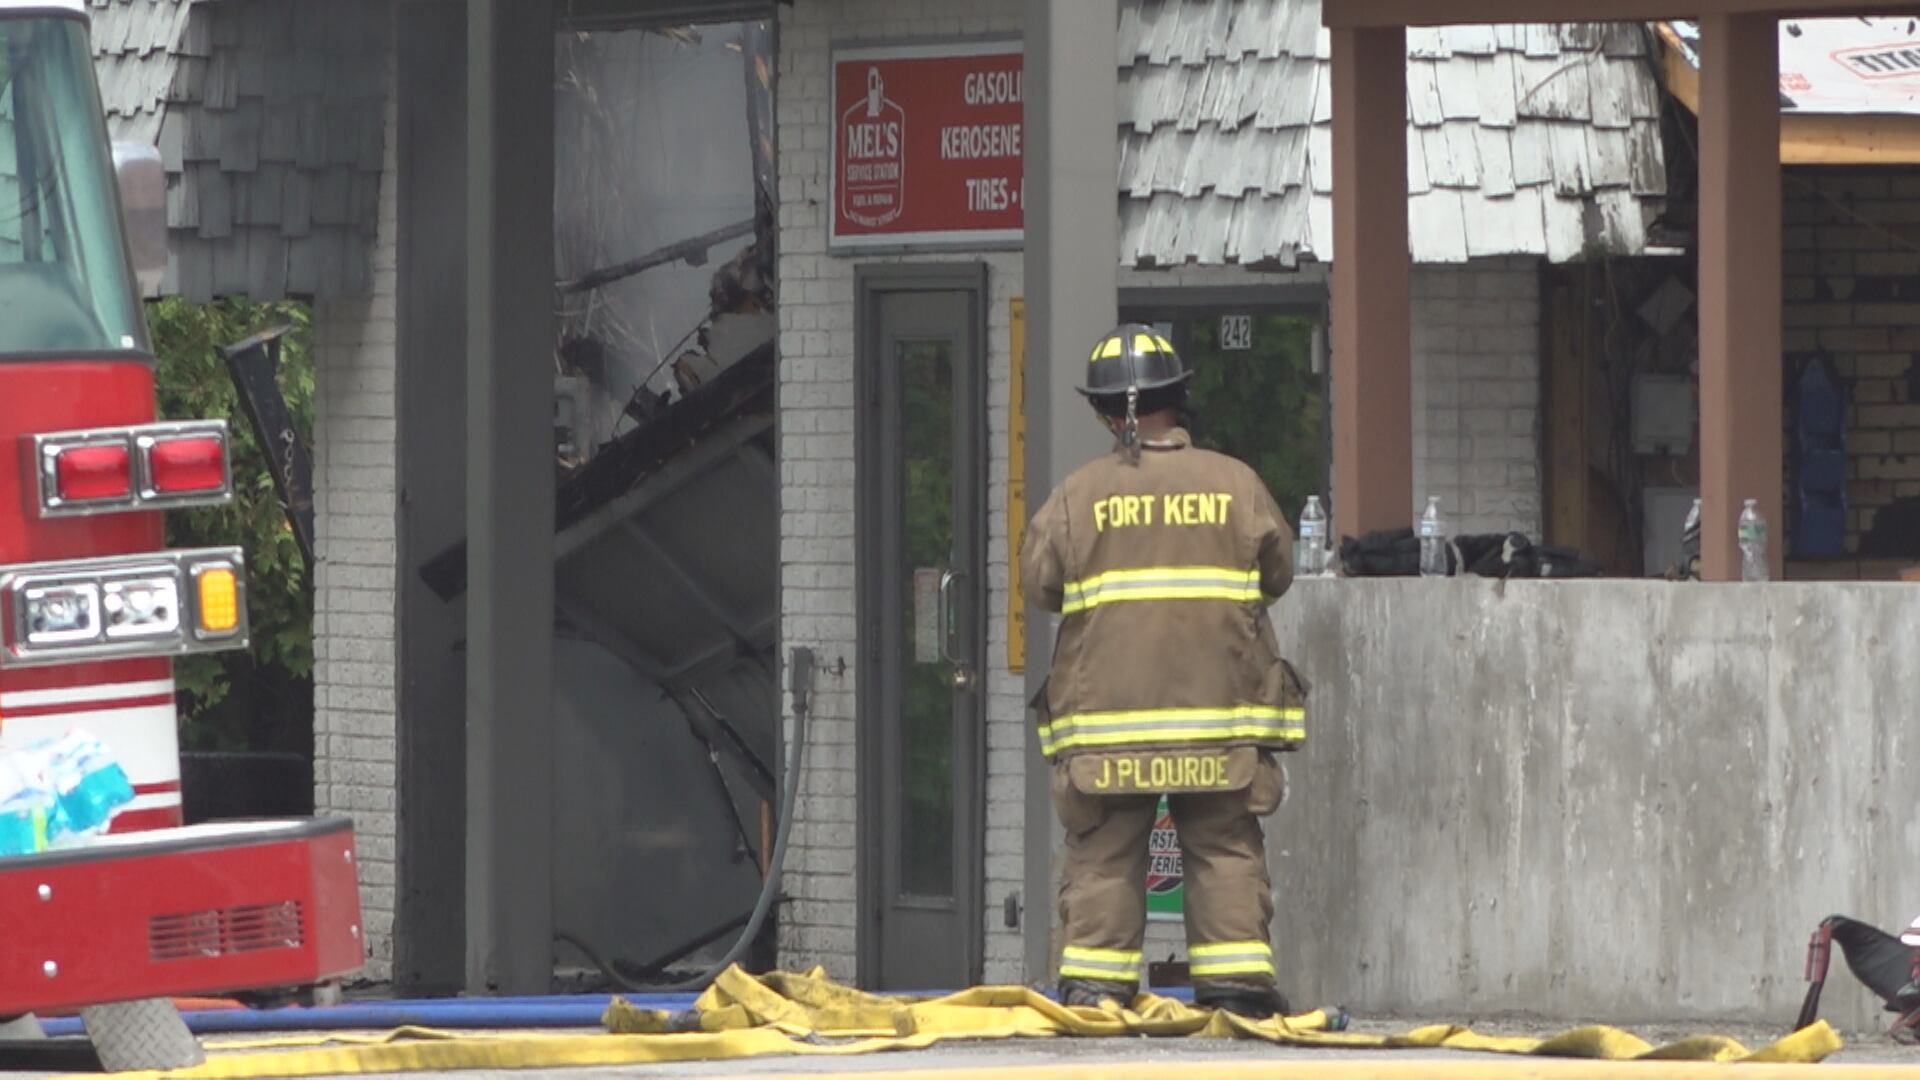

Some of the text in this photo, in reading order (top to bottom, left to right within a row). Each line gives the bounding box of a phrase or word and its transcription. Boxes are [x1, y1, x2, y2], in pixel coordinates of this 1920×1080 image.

[964, 71, 1024, 105] GASOLI
[848, 122, 898, 160] MEL'S
[941, 123, 1021, 159] KEROSENE
[966, 177, 1008, 211] TIRES
[1223, 318, 1249, 347] 242
[1094, 493, 1232, 532] FORT KENT
[1095, 756, 1230, 788] J PLOURDE
